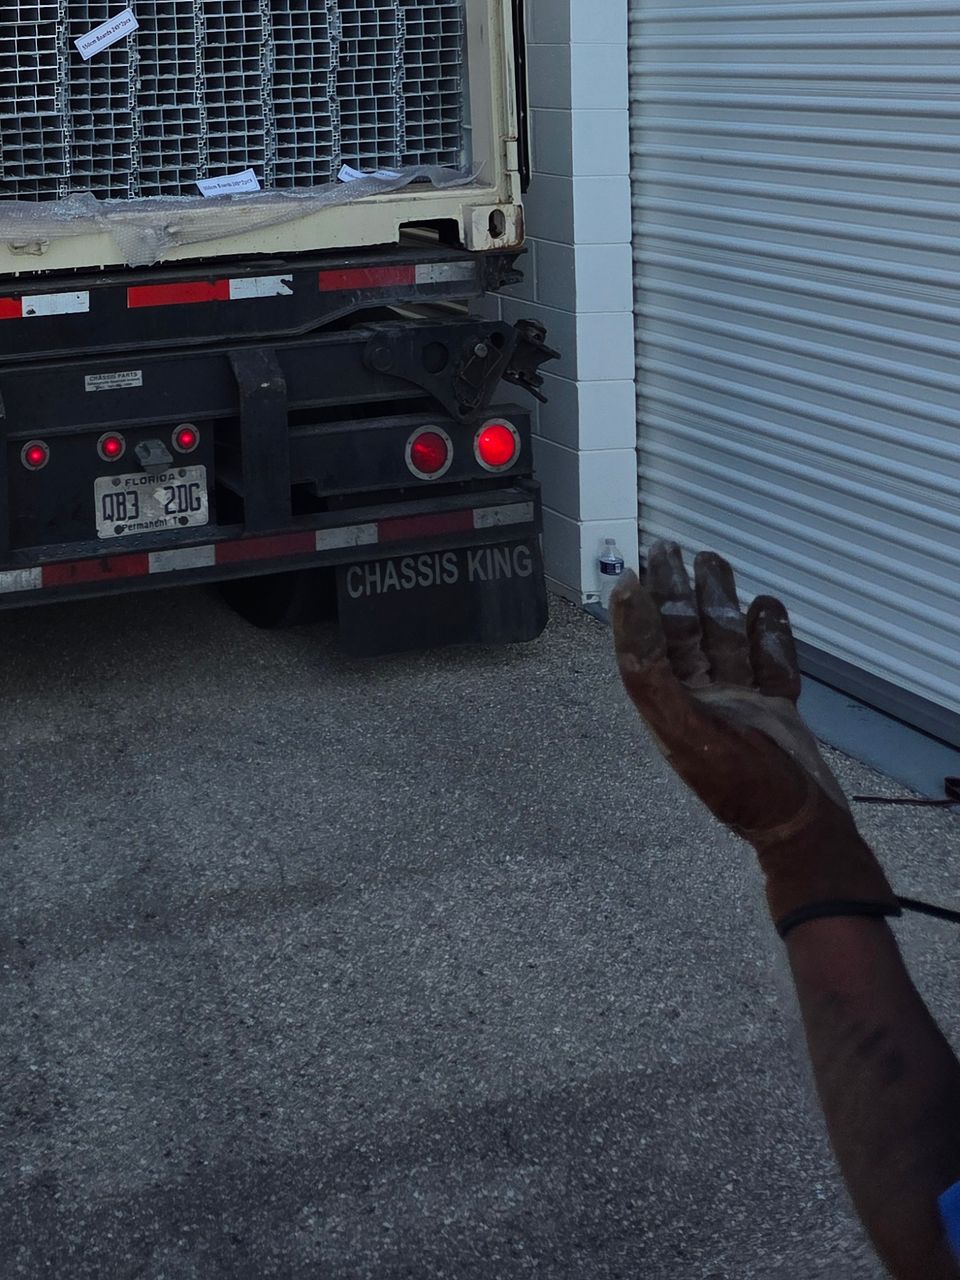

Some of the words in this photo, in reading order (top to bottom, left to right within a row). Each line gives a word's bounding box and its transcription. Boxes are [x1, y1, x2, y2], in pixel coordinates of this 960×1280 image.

[124, 473, 175, 487] FLORIDA
[121, 518, 168, 533] Permanent
[346, 552, 459, 599] CHASSIS
[467, 545, 533, 582] KING
